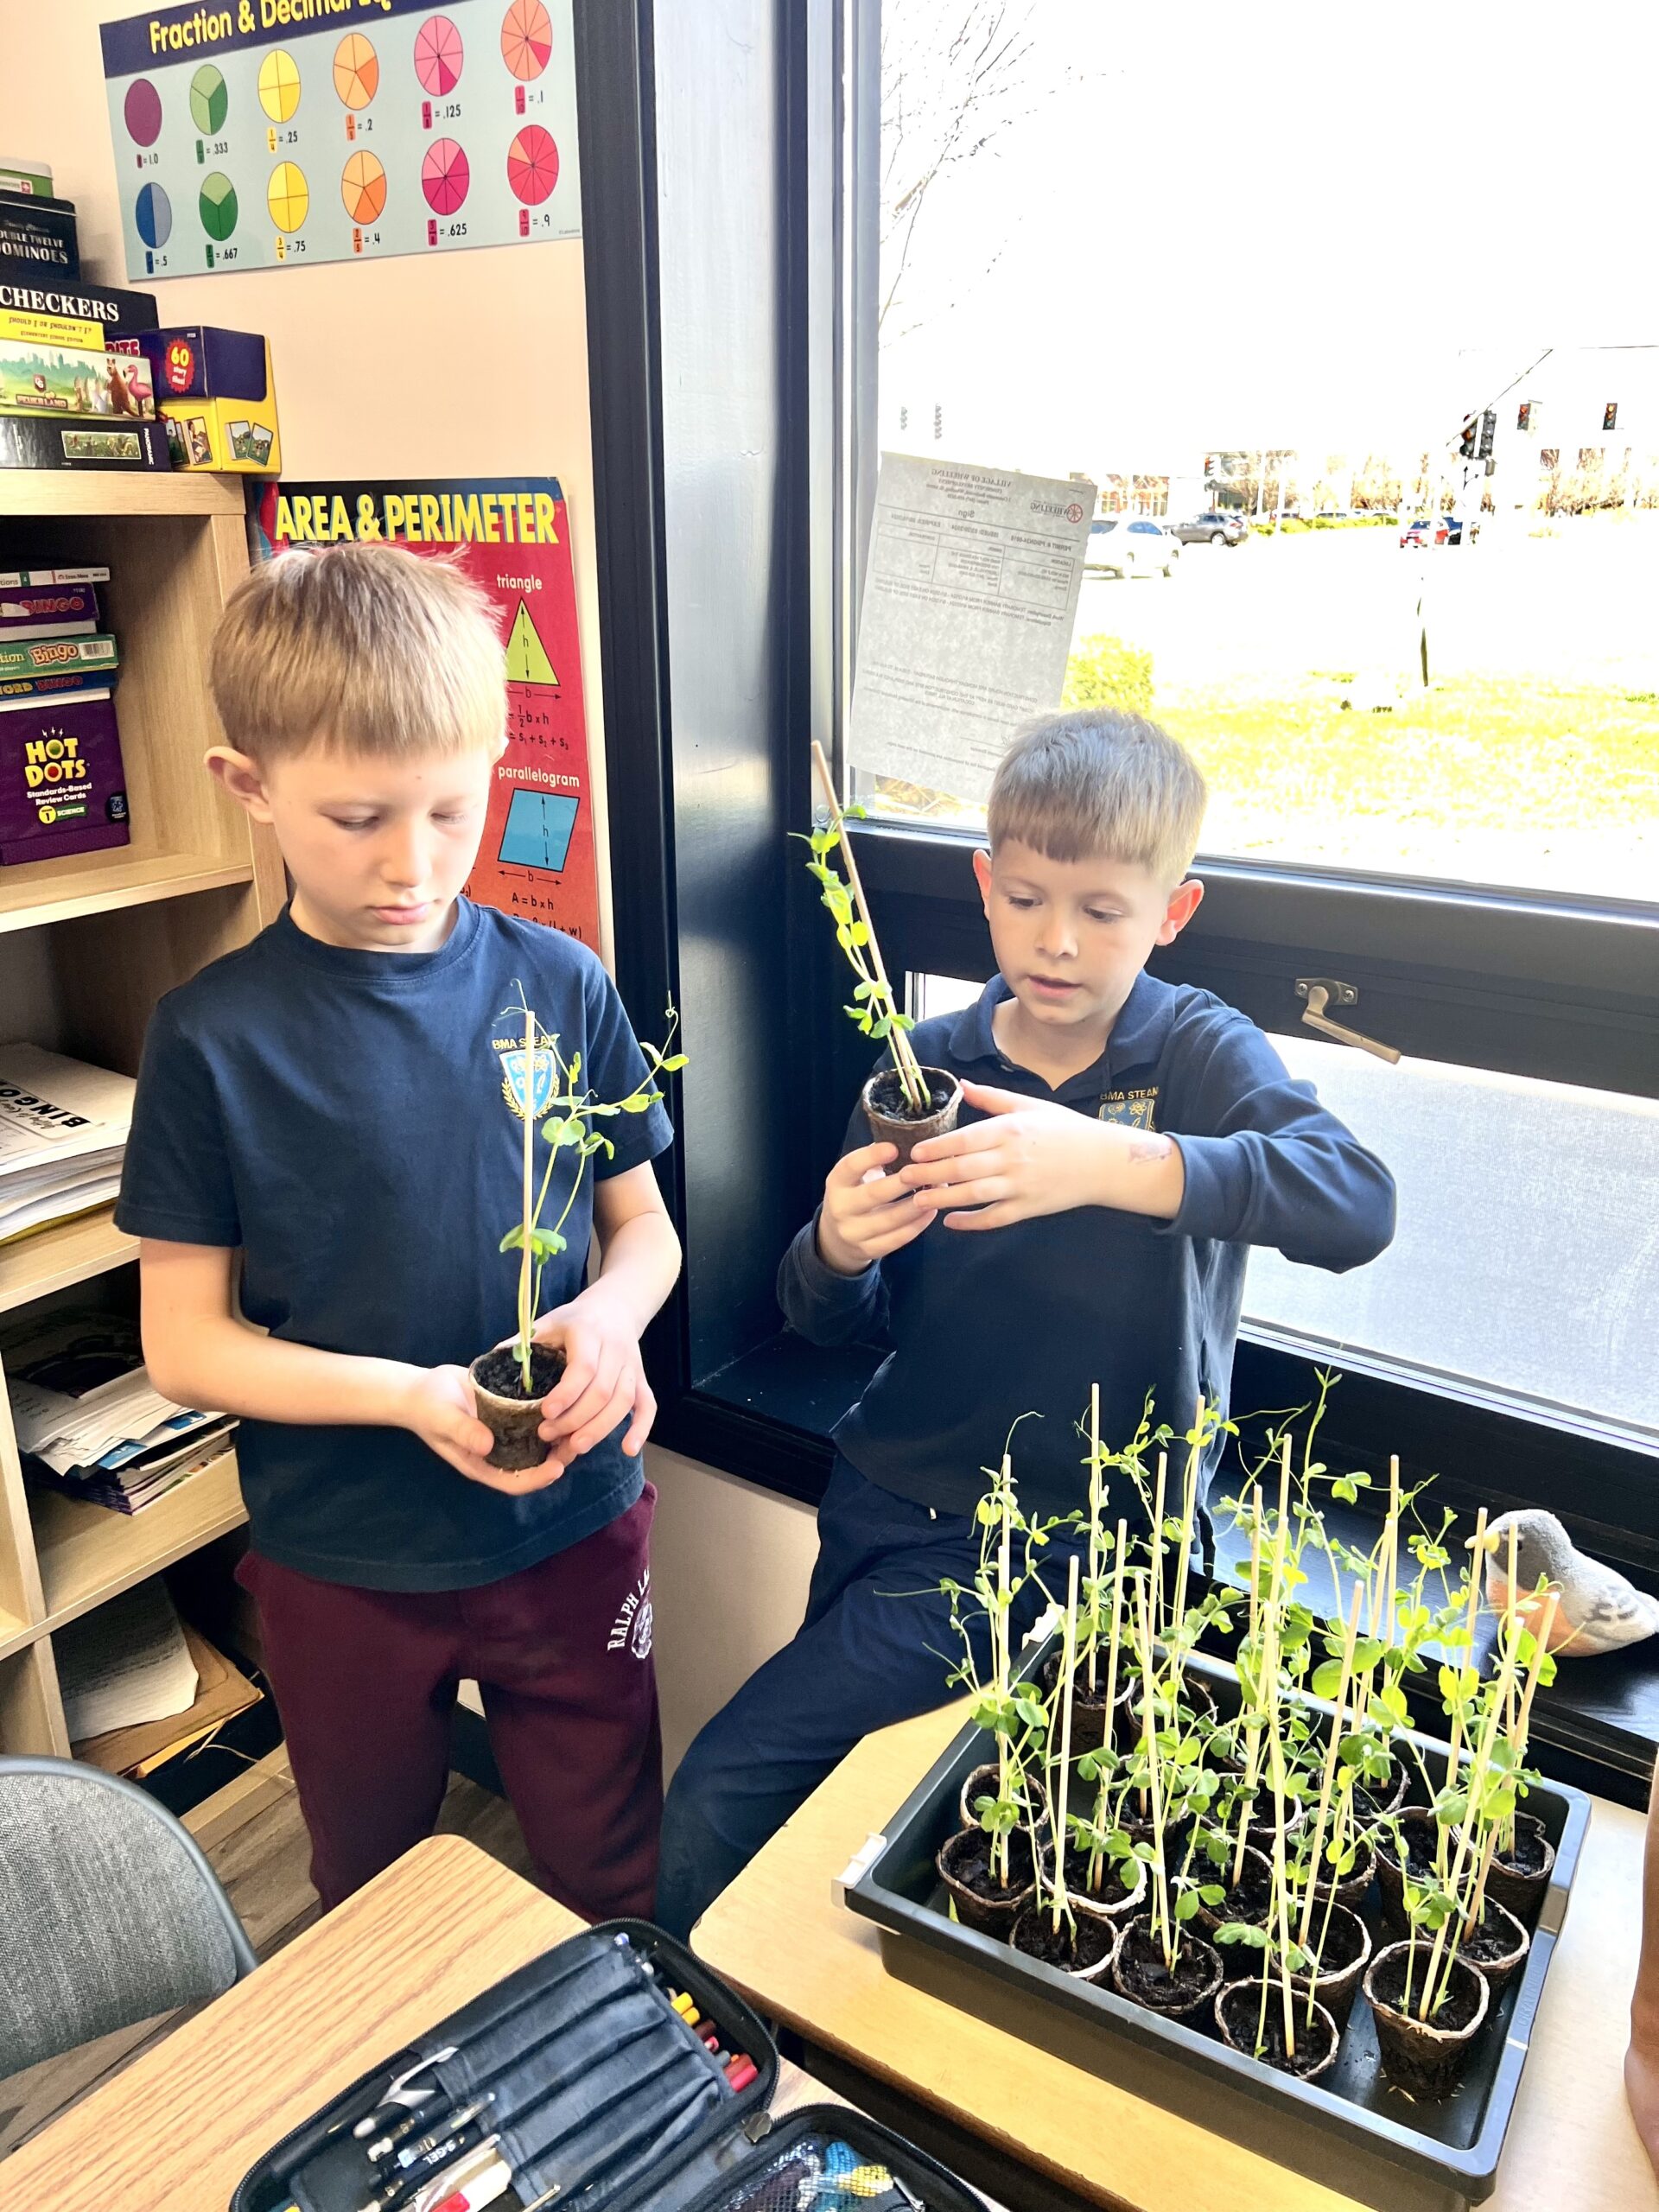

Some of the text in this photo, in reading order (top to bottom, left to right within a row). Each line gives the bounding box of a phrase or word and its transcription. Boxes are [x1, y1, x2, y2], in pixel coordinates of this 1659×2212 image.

[149, 9, 232, 54] Fraction
[238, 0, 256, 34] &
[537, 90, 543, 104] .1
[442, 105, 461, 119] .125
[365, 118, 372, 131] .2
[286, 130, 298, 143] .25
[213, 142, 228, 156] .333
[149, 153, 158, 165] 1.0
[541, 213, 550, 228] .9
[448, 223, 467, 238] .625
[29, 234, 64, 248] TWELVE
[294, 240, 306, 252] .75
[372, 232, 380, 245] .4
[0, 242, 68, 264] OMINOES
[161, 255, 168, 266] .5
[222, 247, 238, 260] .667
[0, 285, 119, 322] CHECKERS
[9, 316, 32, 326] SHOULD
[171, 346, 190, 367] 60
[143, 428, 154, 466] PANORAMIC
[275, 493, 559, 543] AREA & PERIMETER
[497, 574, 543, 594] triangle
[20, 596, 85, 614] BINGO
[522, 635, 529, 647] h
[29, 644, 79, 665] Bingo
[35, 676, 83, 691] BINGO
[525, 687, 531, 698] b
[543, 713, 550, 725] h
[25, 737, 79, 765] HOT
[24, 759, 86, 788] DOTS
[498, 766, 580, 788] parallelogram
[27, 782, 92, 798] Standards-Based
[35, 791, 87, 805] Review Cards
[45, 806, 86, 822] 1 SCIENCE
[543, 825, 549, 837] h
[528, 870, 534, 882] b
[512, 893, 519, 903] A
[531, 895, 537, 906] b
[548, 899, 554, 910] h
[492, 1035, 551, 1050] BMA SEA
[0, 1088, 92, 1128] BINGO
[607, 1592, 640, 1651] RALPH
